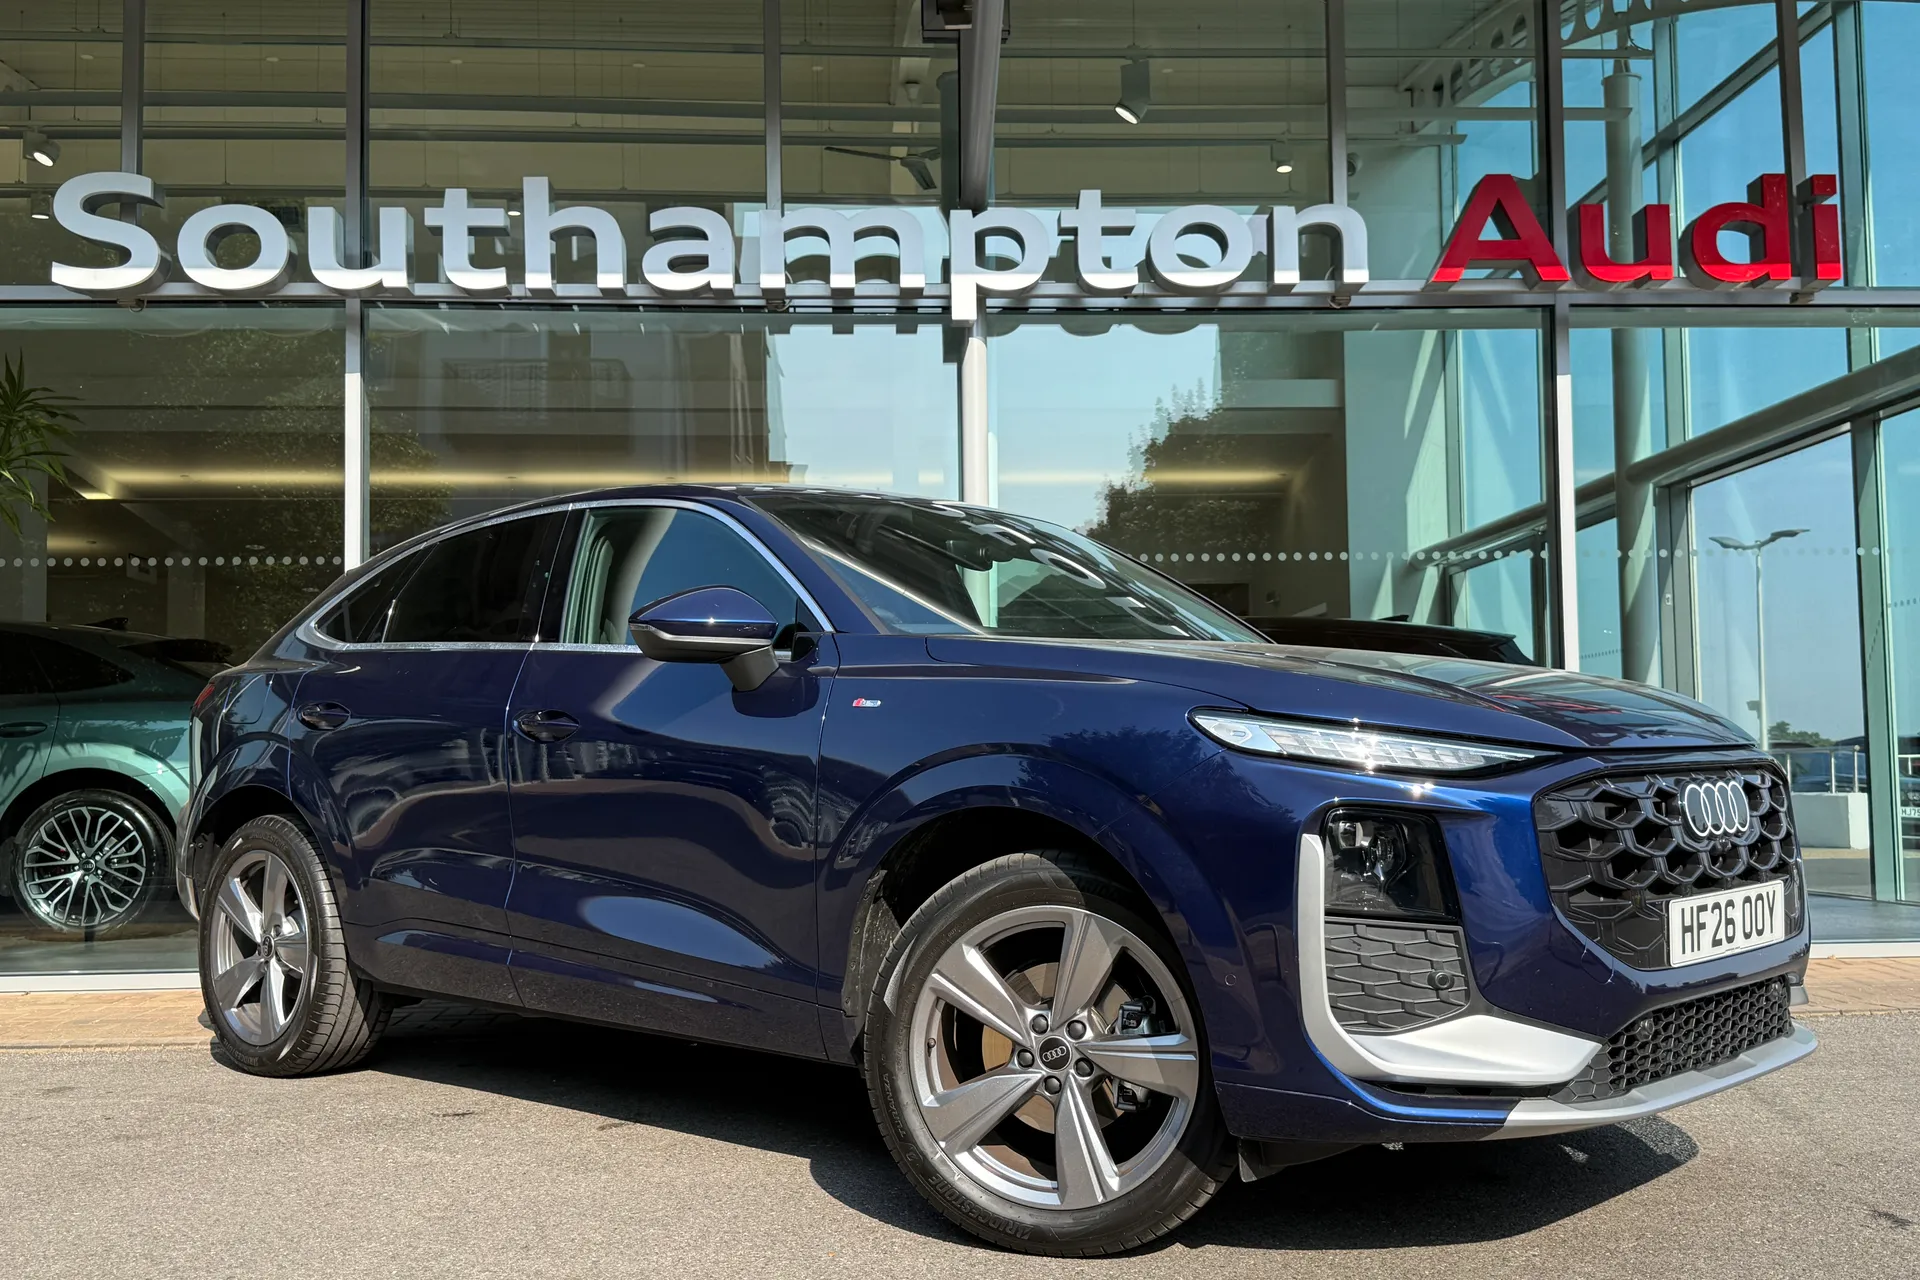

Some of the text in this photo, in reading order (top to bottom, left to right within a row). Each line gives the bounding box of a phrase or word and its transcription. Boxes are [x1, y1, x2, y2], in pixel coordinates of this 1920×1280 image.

[51, 172, 1840, 322] Southampton Audi
[1680, 889, 1776, 955] HF26 OOY
[882, 1073, 907, 1138] TURANZA
[927, 1173, 1034, 1240] BRIDGESTONE
